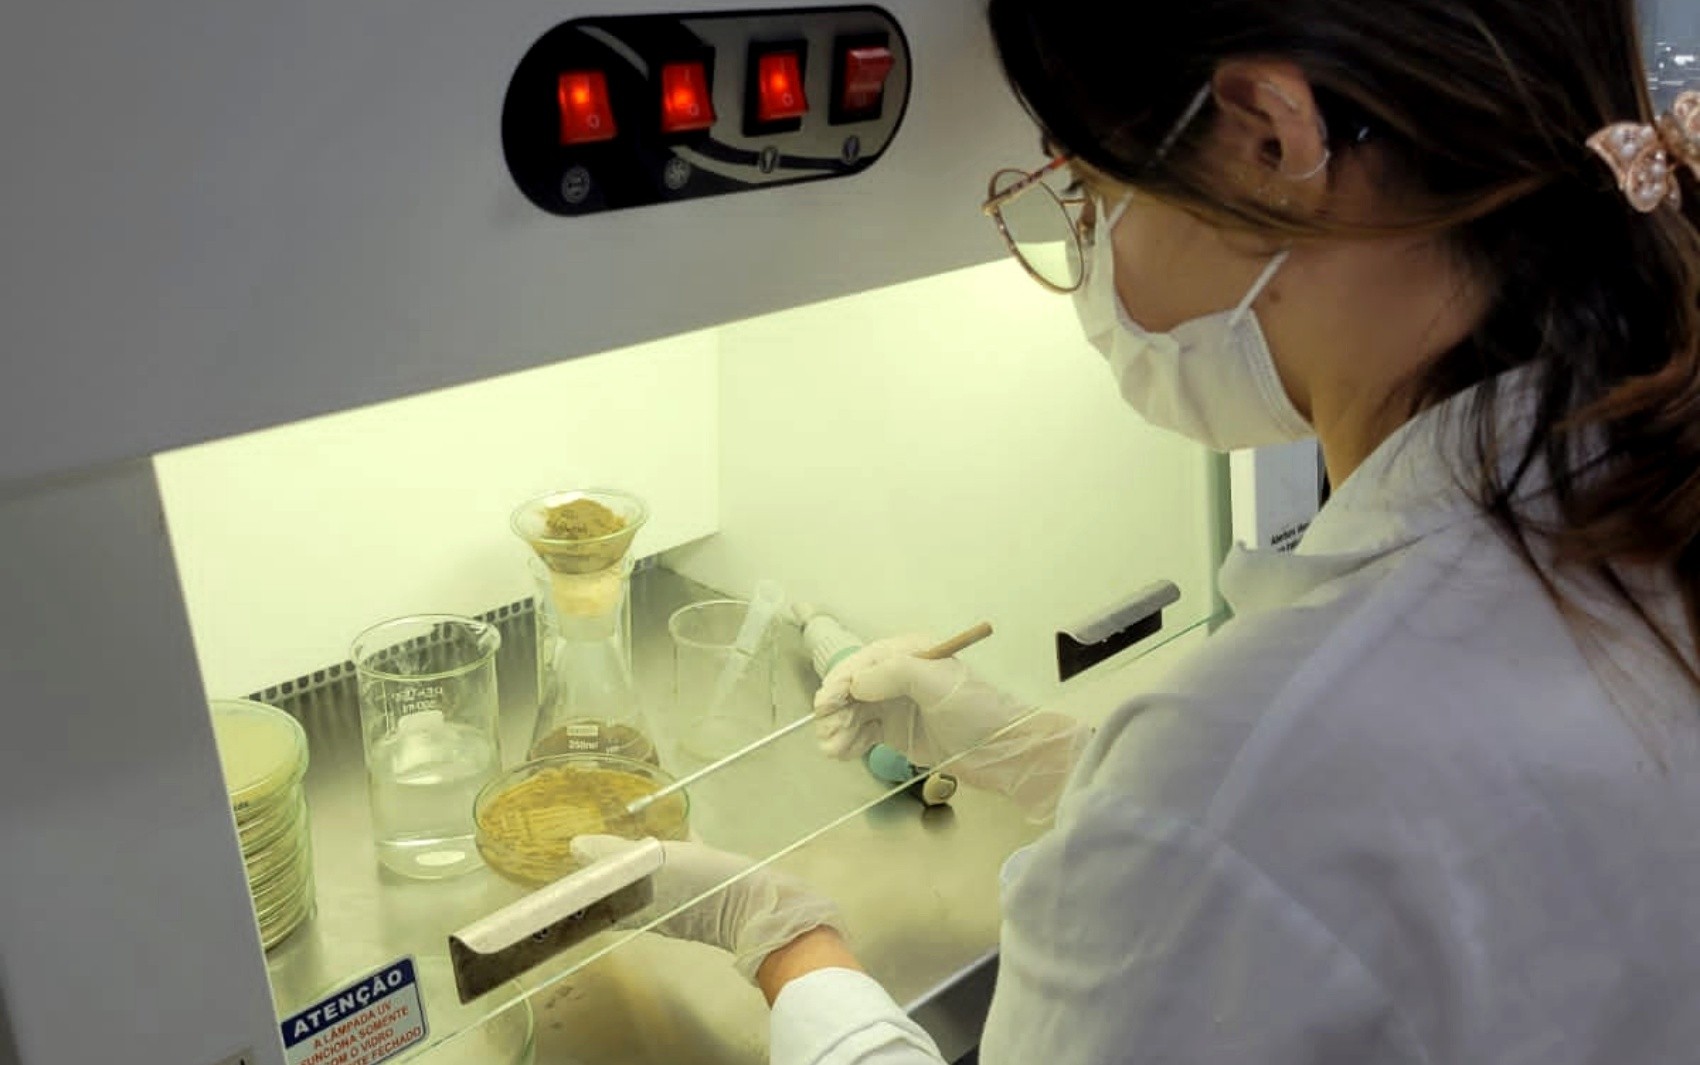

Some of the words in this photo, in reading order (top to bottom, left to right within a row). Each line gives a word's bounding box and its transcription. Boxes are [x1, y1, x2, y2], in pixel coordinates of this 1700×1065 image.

[294, 968, 403, 1038] ATENÇÃO
[359, 1005, 409, 1037] SOMENTE
[360, 1028, 395, 1052] VIDRO
[372, 1026, 422, 1060] FECHADO
